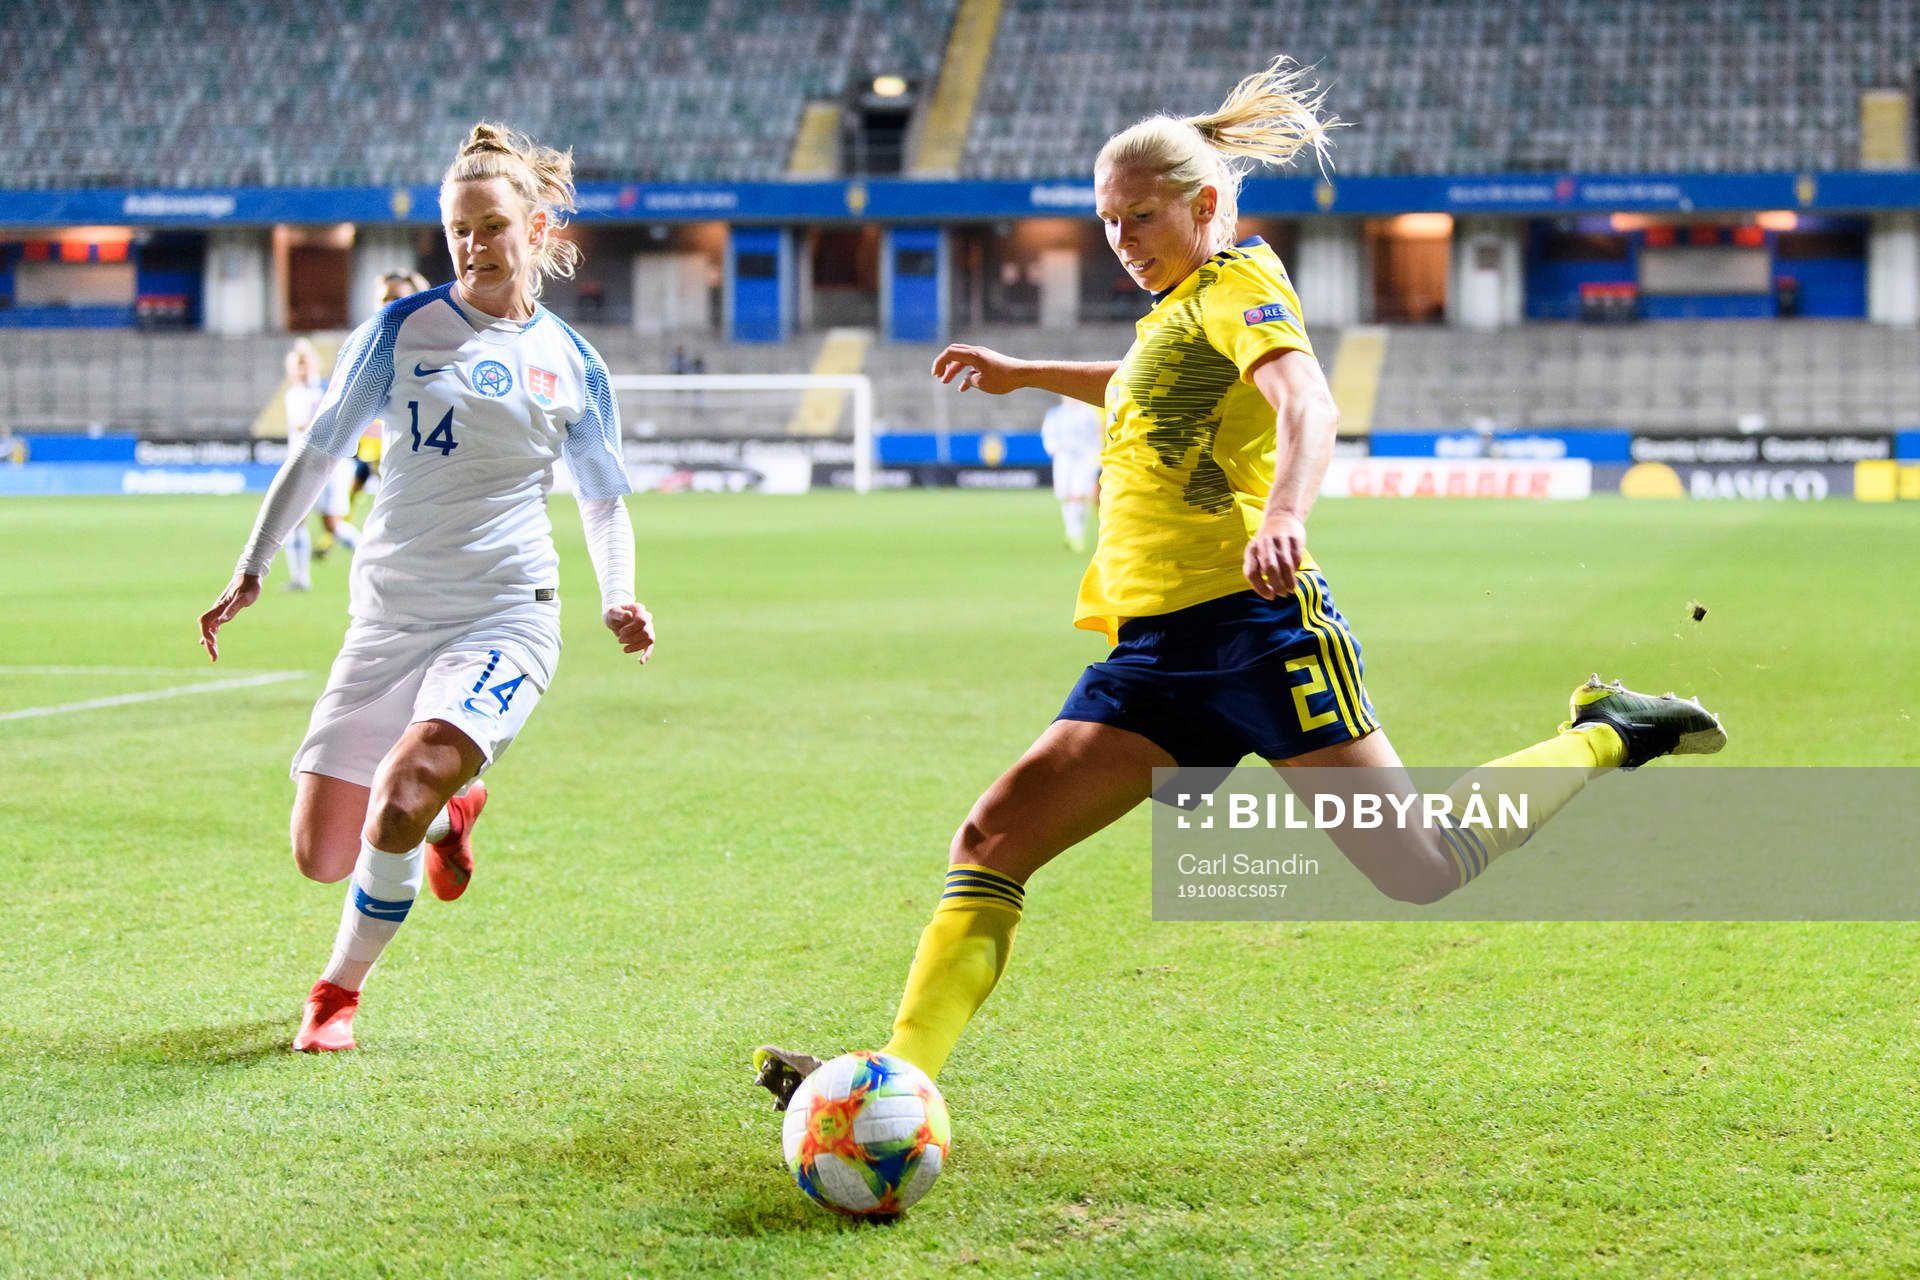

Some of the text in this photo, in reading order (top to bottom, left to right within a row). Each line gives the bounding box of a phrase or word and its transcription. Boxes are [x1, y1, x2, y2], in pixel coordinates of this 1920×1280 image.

[408, 401, 459, 456] 14
[472, 649, 530, 715] 14
[1284, 654, 1339, 733] 2
